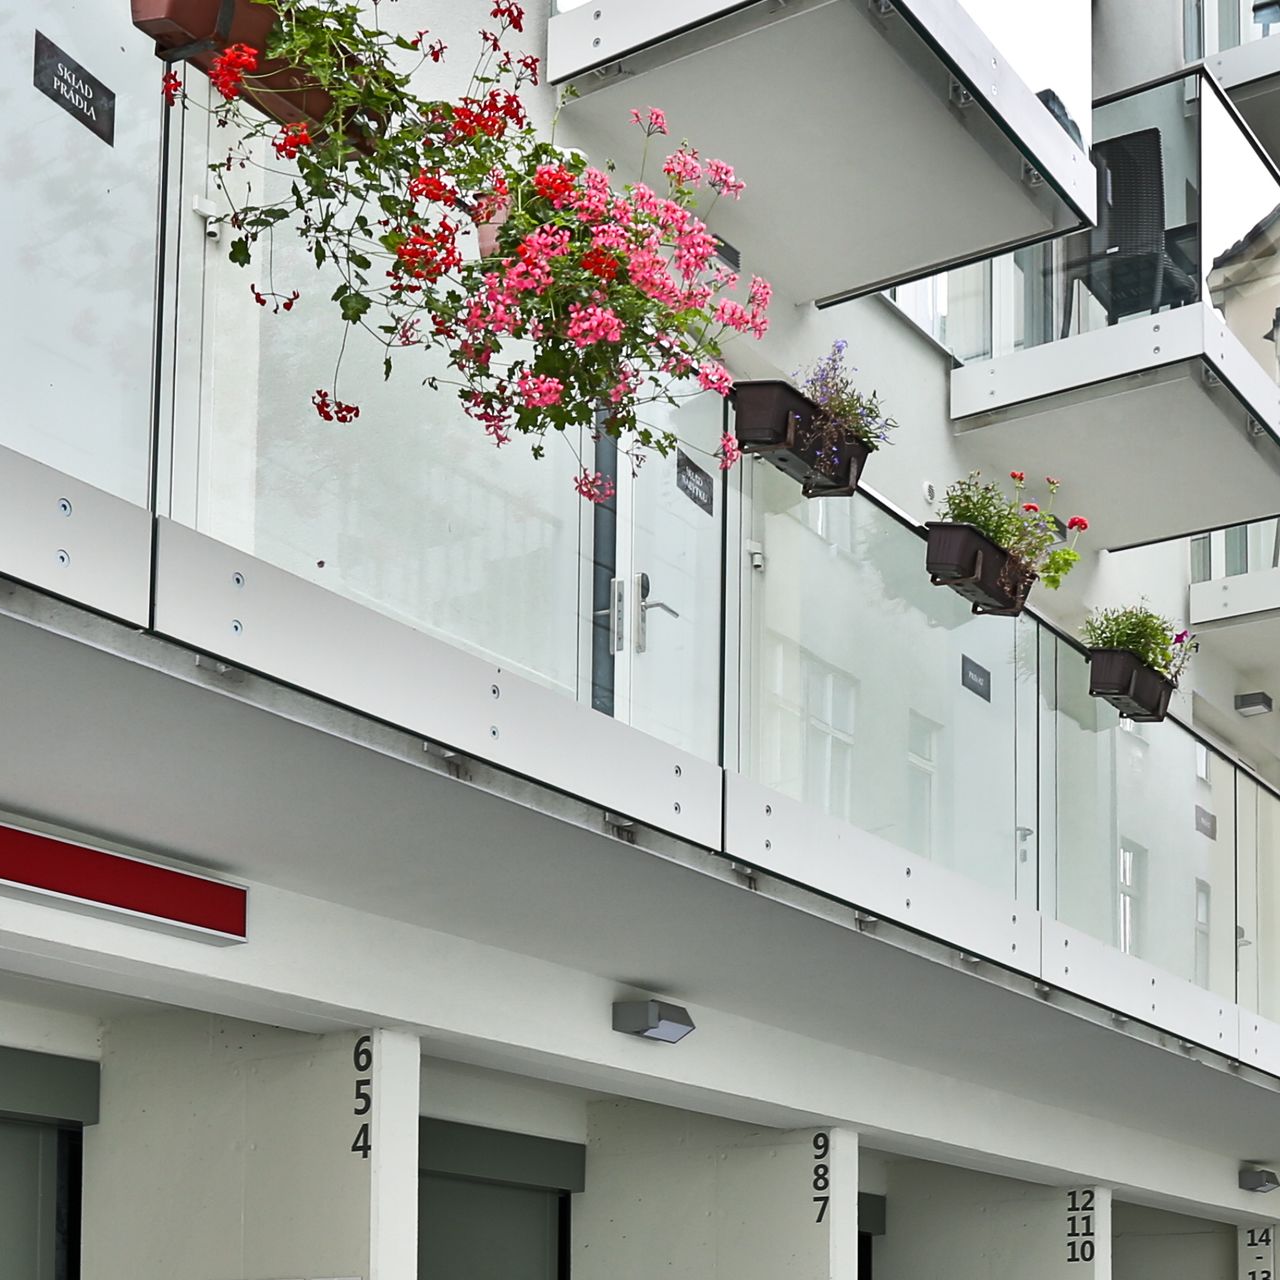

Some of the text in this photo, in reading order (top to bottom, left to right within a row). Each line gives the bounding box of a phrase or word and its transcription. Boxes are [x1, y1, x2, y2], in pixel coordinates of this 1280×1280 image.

[57, 62, 93, 99] SKLAD
[52, 76, 97, 121] PRÁDLA
[353, 1035, 373, 1072] 6
[353, 1079, 372, 1116] 5
[351, 1123, 372, 1159] 4
[812, 1132, 830, 1160] 9
[812, 1163, 830, 1191] 8
[812, 1196, 830, 1223] 7
[1066, 1189, 1095, 1212] 12
[1066, 1215, 1095, 1237] 11
[1246, 1228, 1272, 1247] 14
[1066, 1240, 1095, 1262] 10
